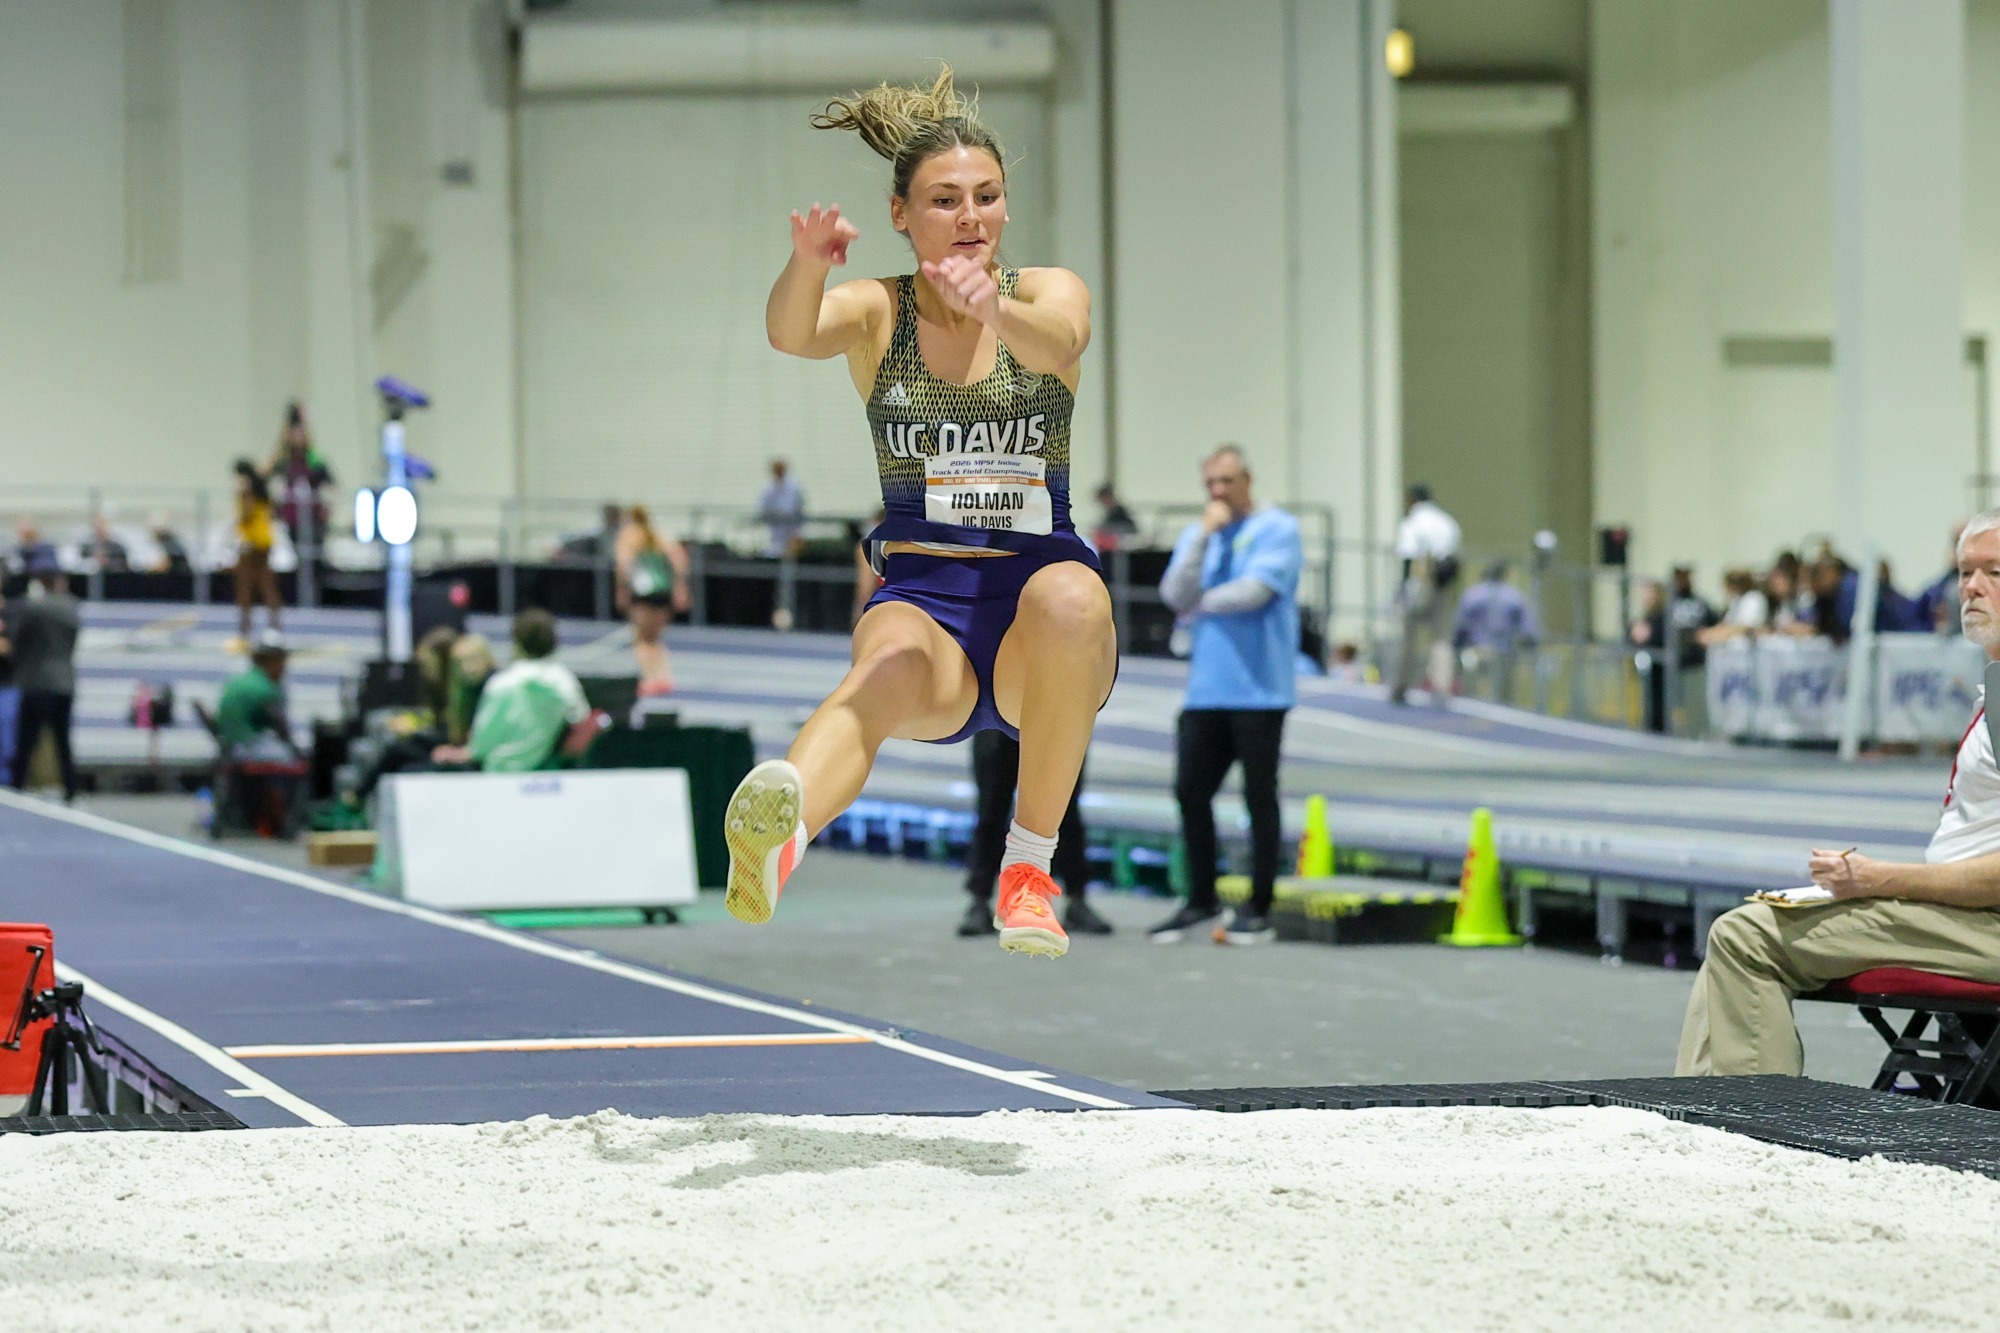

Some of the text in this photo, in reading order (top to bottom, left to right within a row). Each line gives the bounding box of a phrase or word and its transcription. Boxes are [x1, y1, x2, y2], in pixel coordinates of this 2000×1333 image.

[886, 413, 1045, 458] UC DAVIS
[998, 459, 1021, 467] Indoor
[984, 468, 1039, 477] Championships
[951, 492, 1024, 510] HOLMAN
[962, 515, 1012, 528] UC DAVIS
